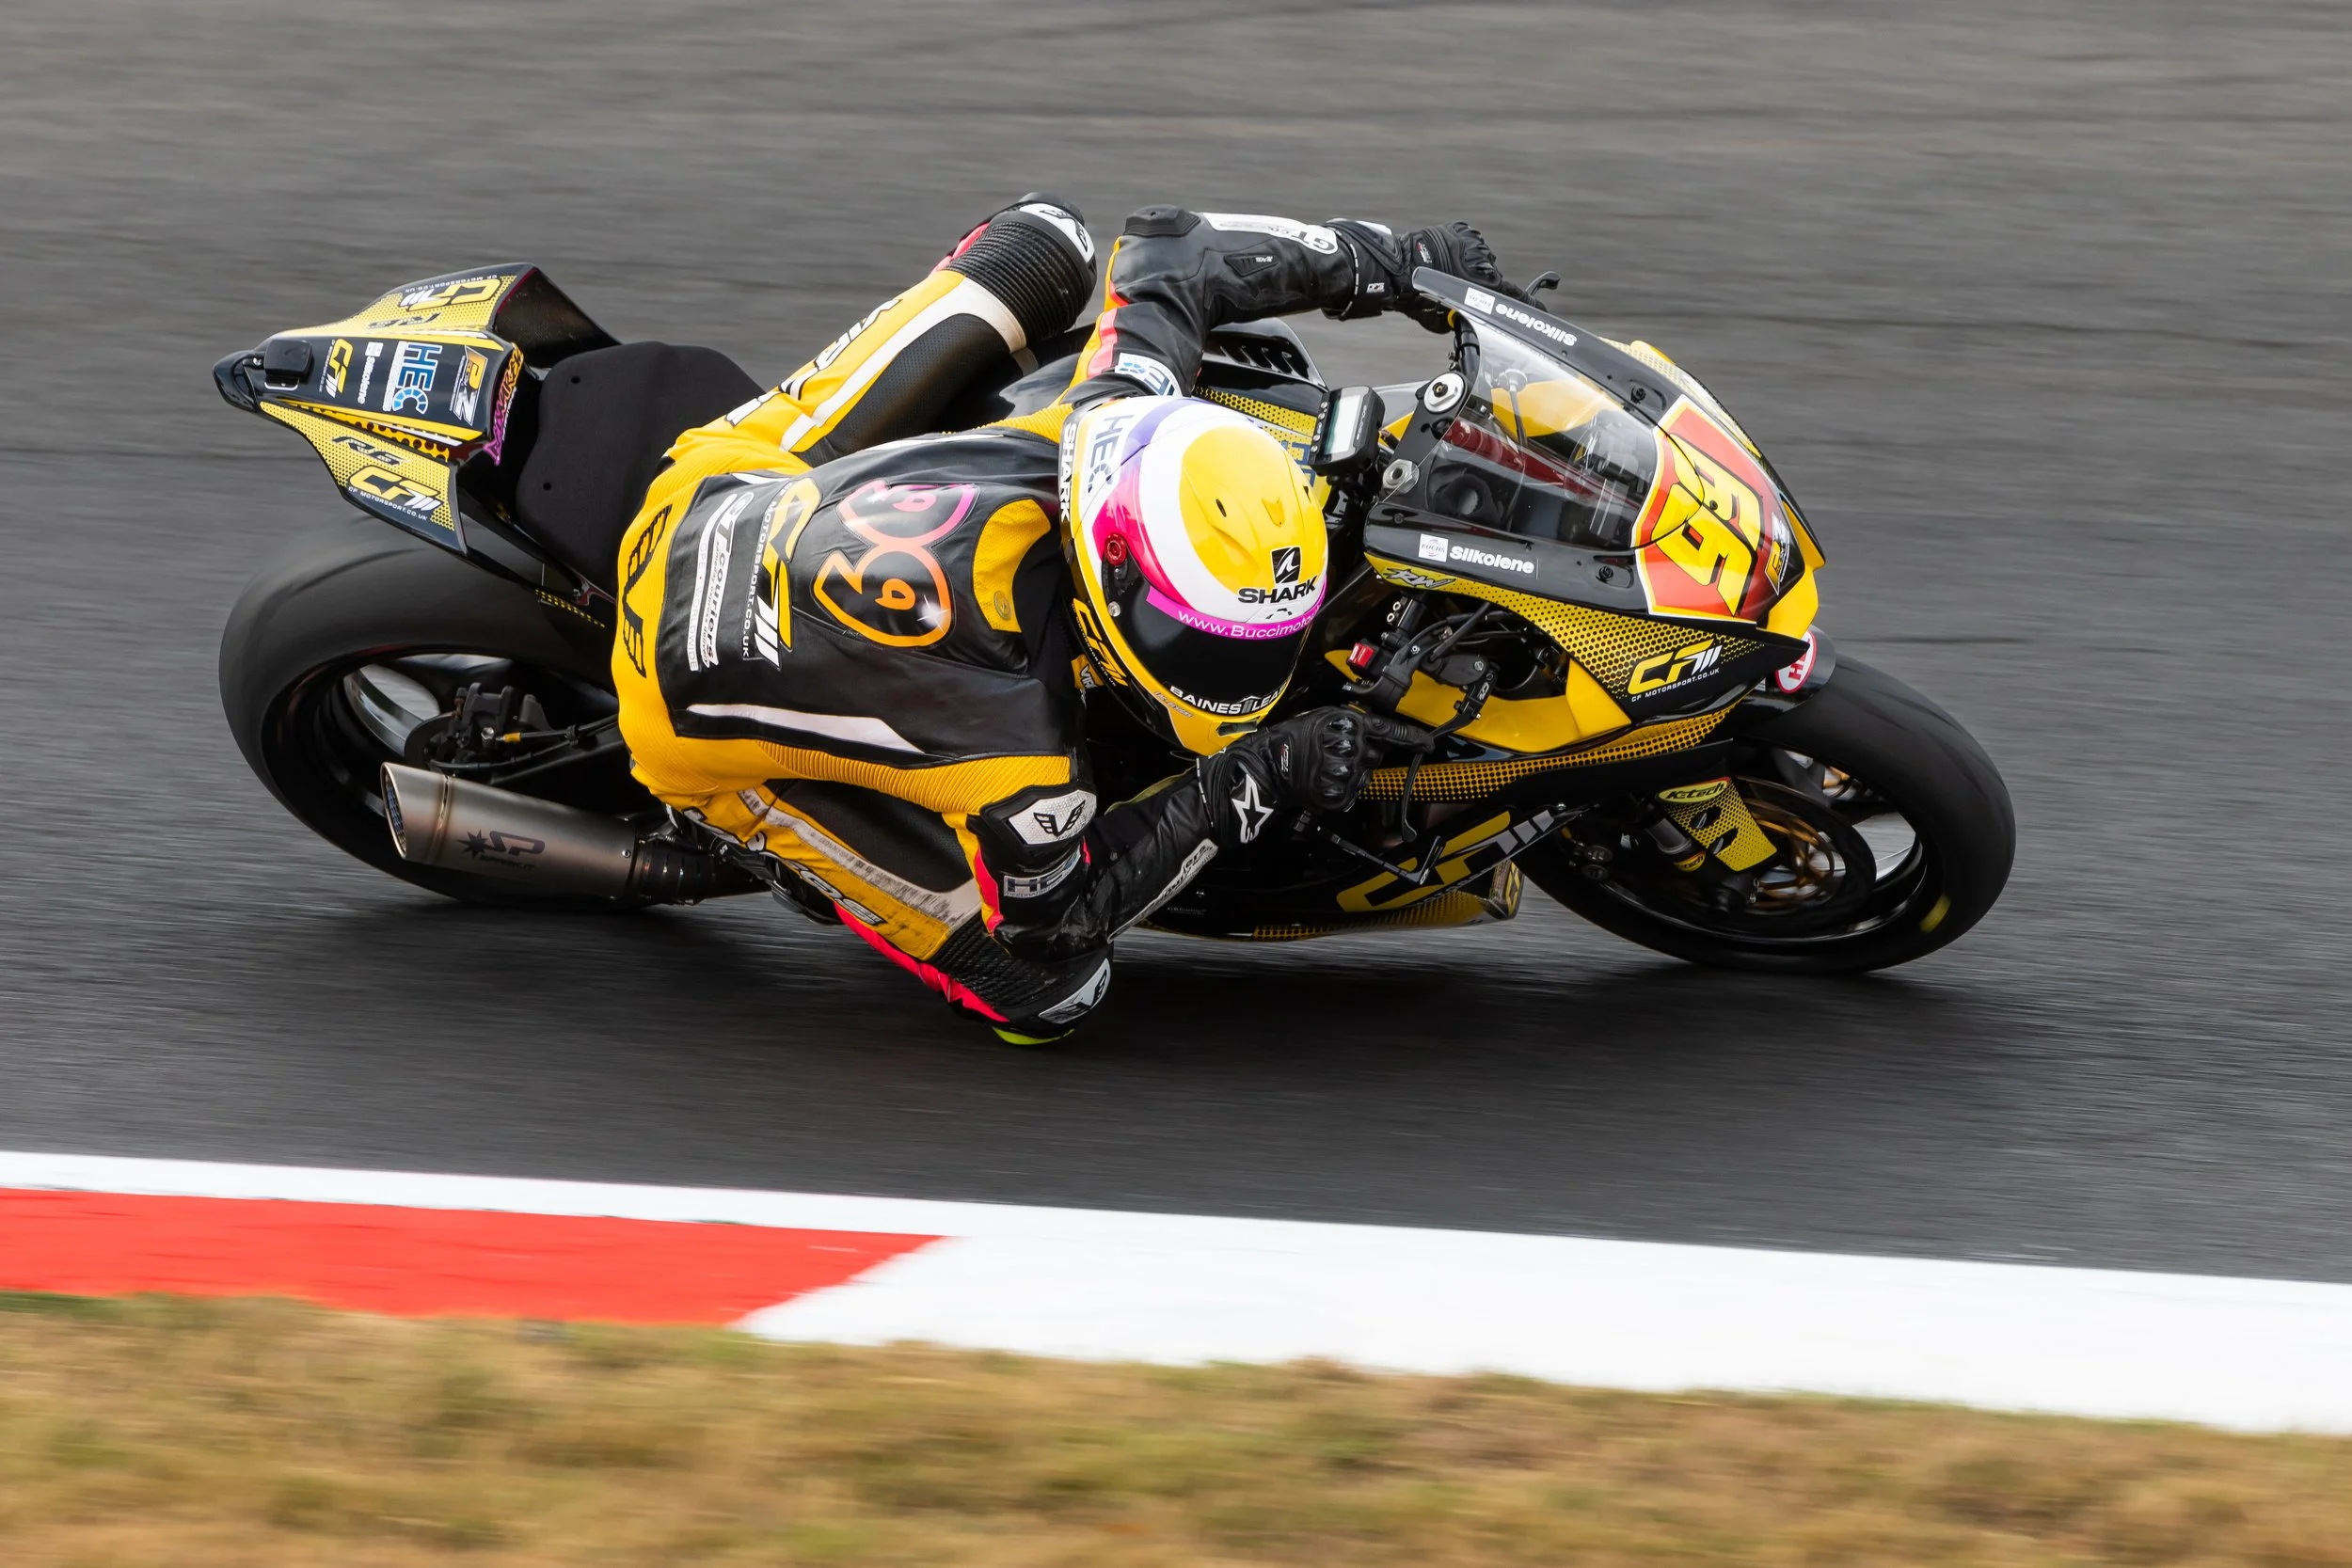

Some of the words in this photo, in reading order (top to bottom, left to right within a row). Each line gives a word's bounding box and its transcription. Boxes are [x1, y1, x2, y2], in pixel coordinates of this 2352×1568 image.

[1290, 230, 1336, 253] GT
[1494, 302, 1578, 347] Silkolene
[358, 357, 375, 404] Silkolene
[390, 341, 443, 415] HEC
[1059, 421, 1077, 522] SHARK
[1087, 414, 1133, 495] HEC
[359, 490, 428, 522] MOTORSPORT.CO.UK
[742, 500, 777, 657] MOTORSPORT.CO.UK
[1449, 546, 1535, 575] Silkolene
[707, 553, 725, 658] couriers
[1237, 575, 1318, 605] SHARK
[1169, 685, 1242, 716] BAINES
[1644, 667, 1721, 699] MOTORSPORT.CO.UK
